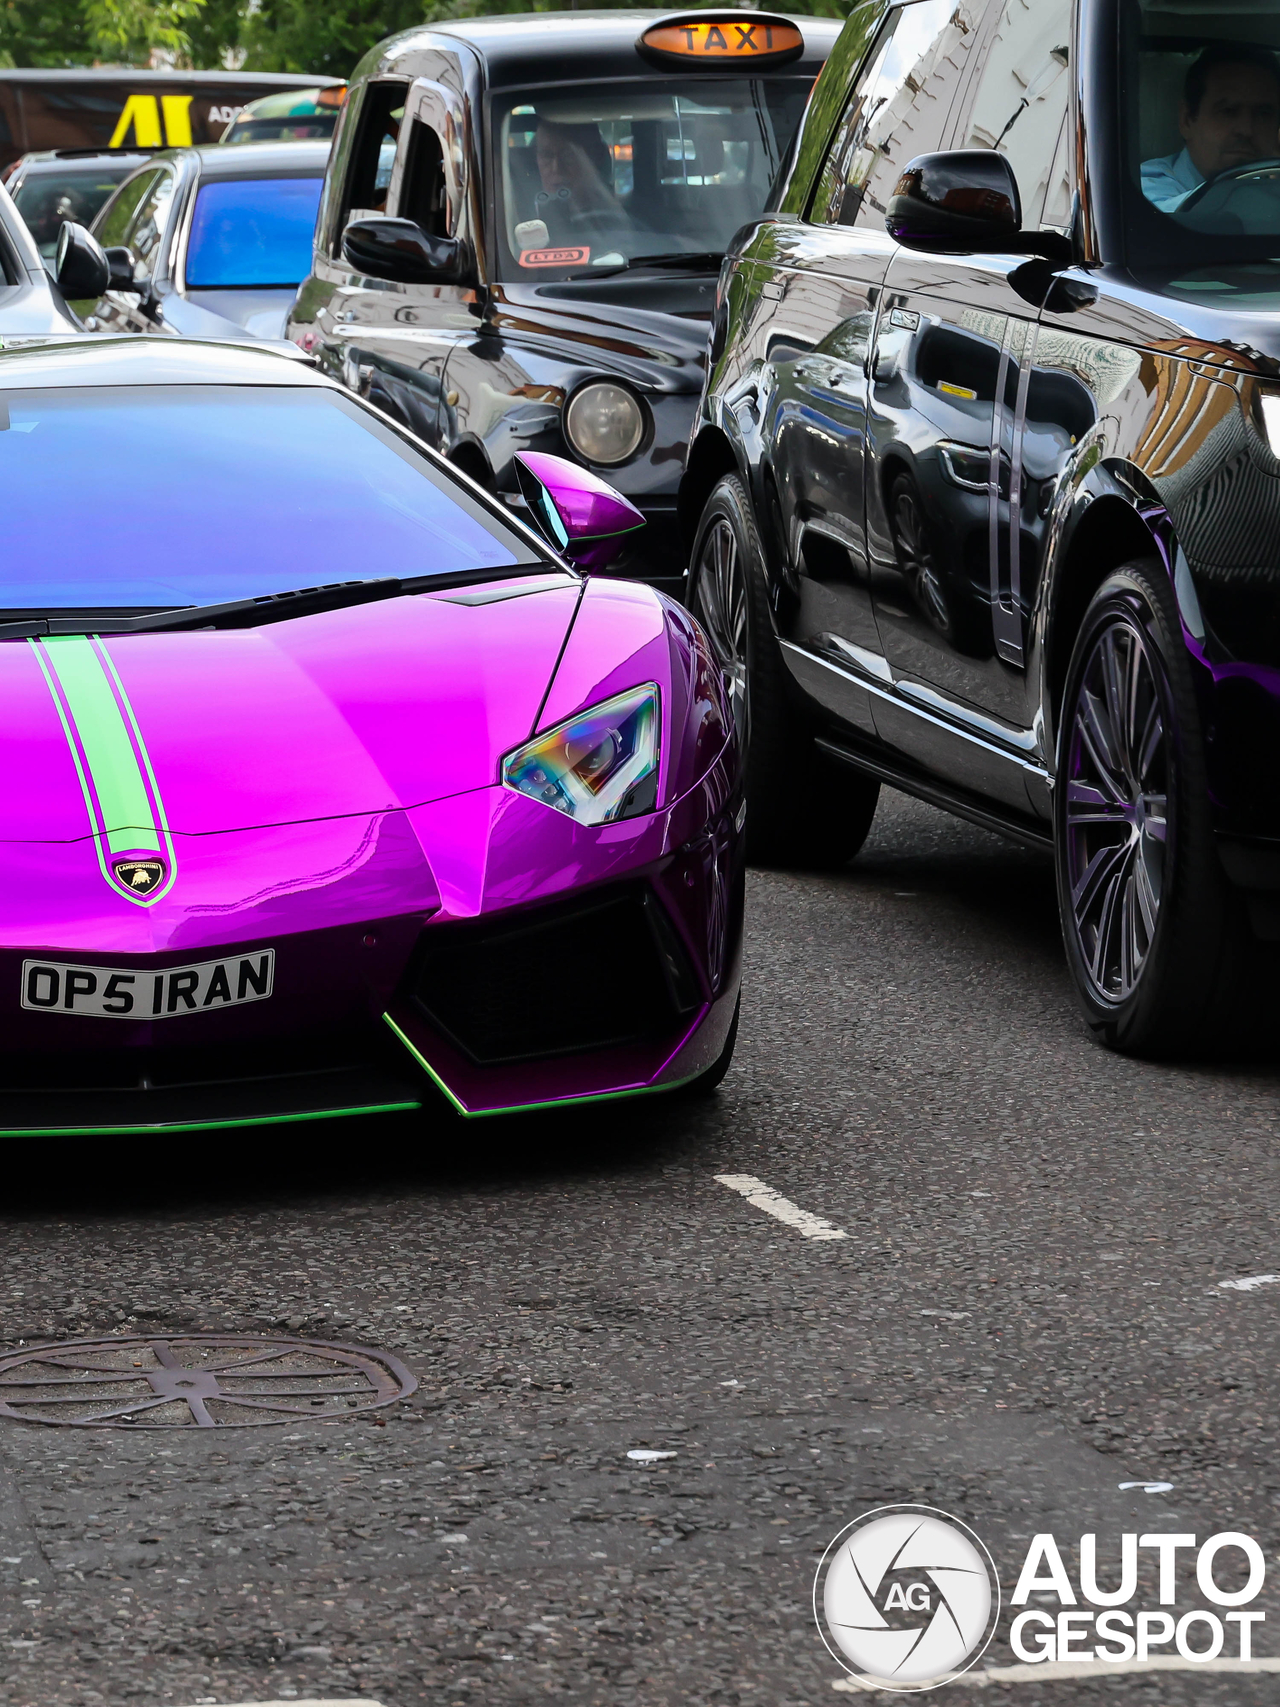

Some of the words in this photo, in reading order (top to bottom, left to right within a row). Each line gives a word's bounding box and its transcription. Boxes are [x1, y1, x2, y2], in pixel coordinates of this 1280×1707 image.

[679, 26, 773, 51] TAXI
[534, 251, 575, 261] LTDA
[119, 864, 159, 872] LAMBORGHINI
